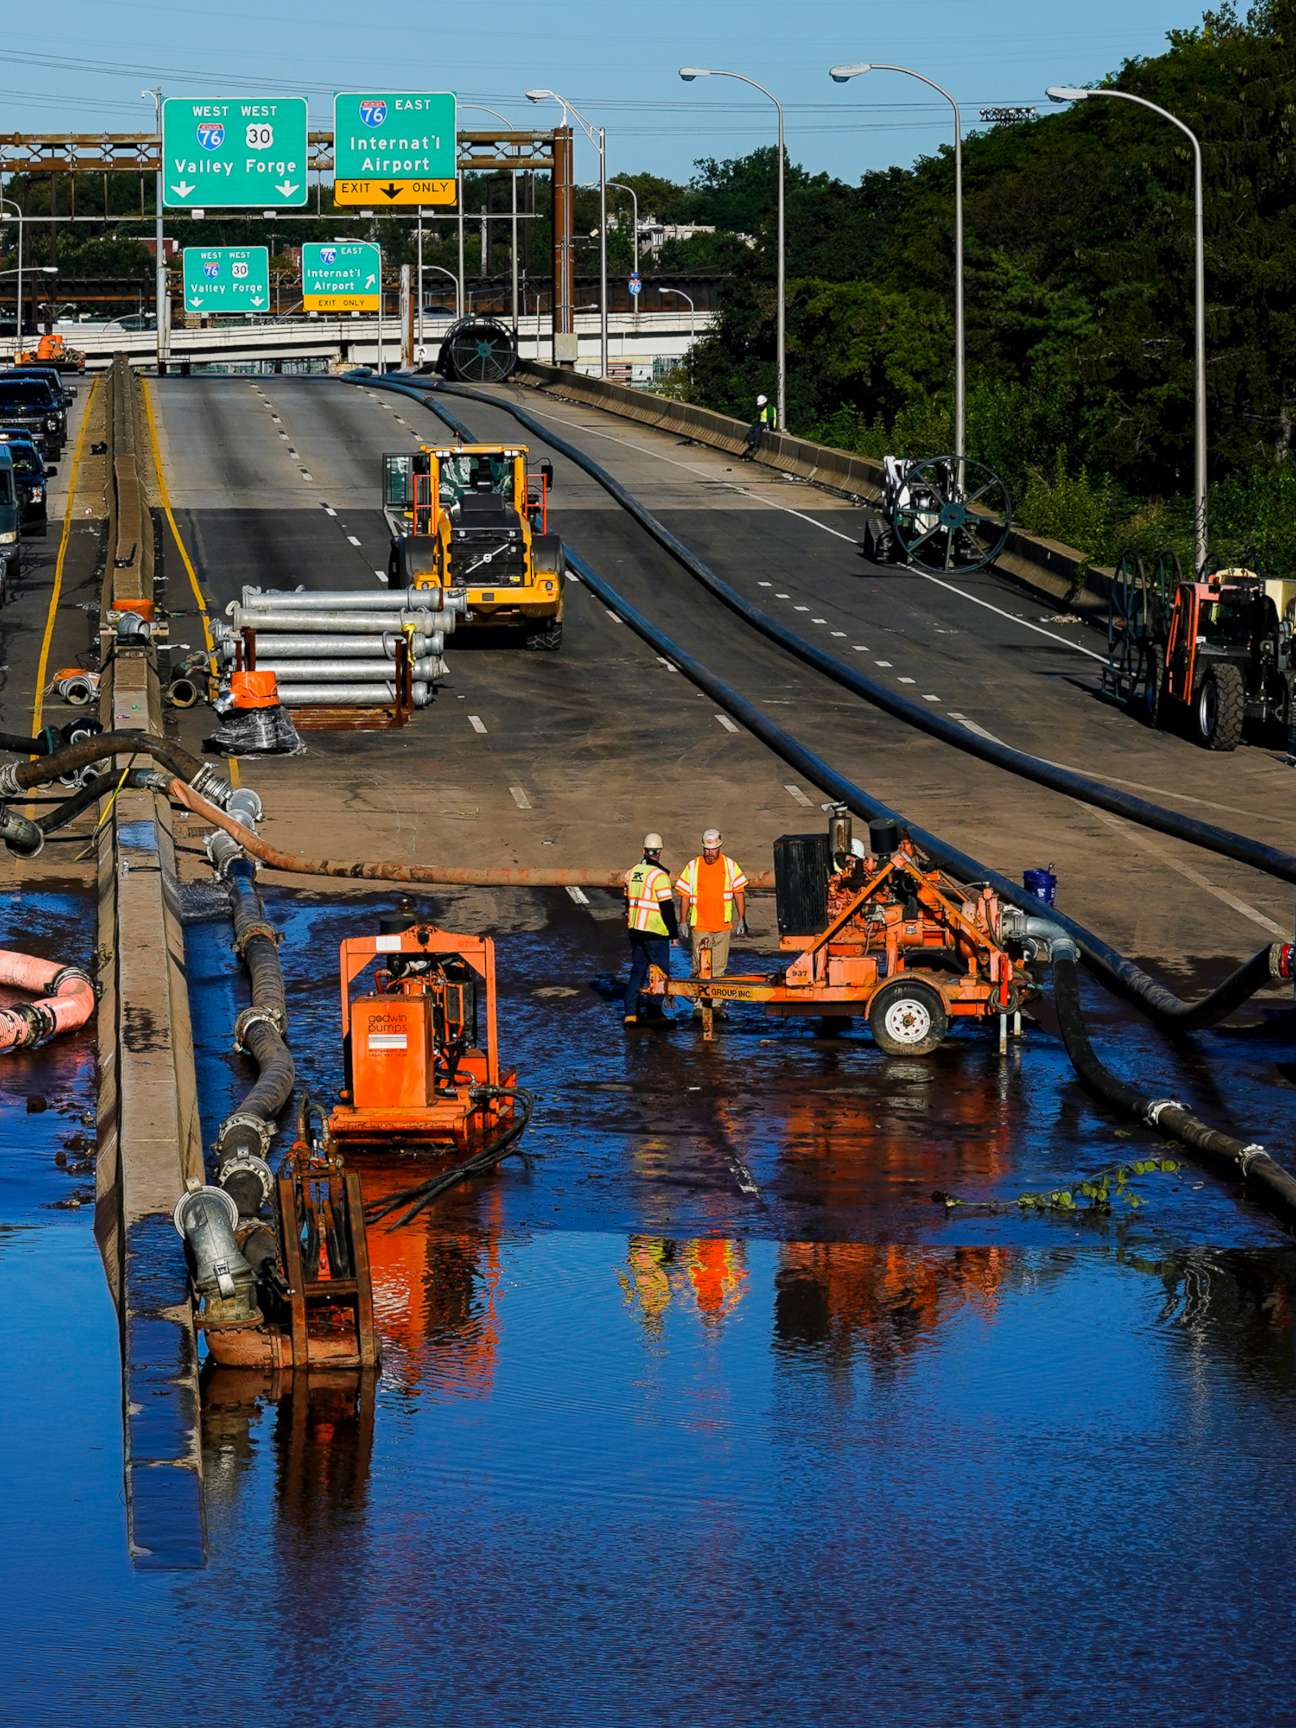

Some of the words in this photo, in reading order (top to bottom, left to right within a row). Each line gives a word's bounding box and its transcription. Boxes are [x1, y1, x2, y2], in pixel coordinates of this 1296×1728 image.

[395, 99, 431, 110] EAST
[192, 106, 229, 117] WEST
[240, 106, 278, 117] WEST
[362, 107, 384, 122] 76
[199, 130, 221, 145] 76
[248, 129, 270, 143] 30
[174, 159, 234, 177] Valley
[245, 159, 297, 177] Forge
[361, 157, 430, 173] Airport
[341, 182, 371, 193] EXIT
[412, 182, 449, 193] ONLY
[200, 251, 223, 260] WEST
[229, 251, 251, 259] WEST
[322, 252, 335, 261] 76
[341, 247, 363, 255] EAST
[206, 266, 218, 276] 76
[233, 265, 247, 275] 30
[190, 283, 226, 295] Valley
[232, 283, 263, 294] Forge
[314, 281, 355, 292] Airport
[318, 299, 336, 307] EXIT
[367, 1013, 408, 1025] godwin
[367, 1024, 408, 1035] pumps
